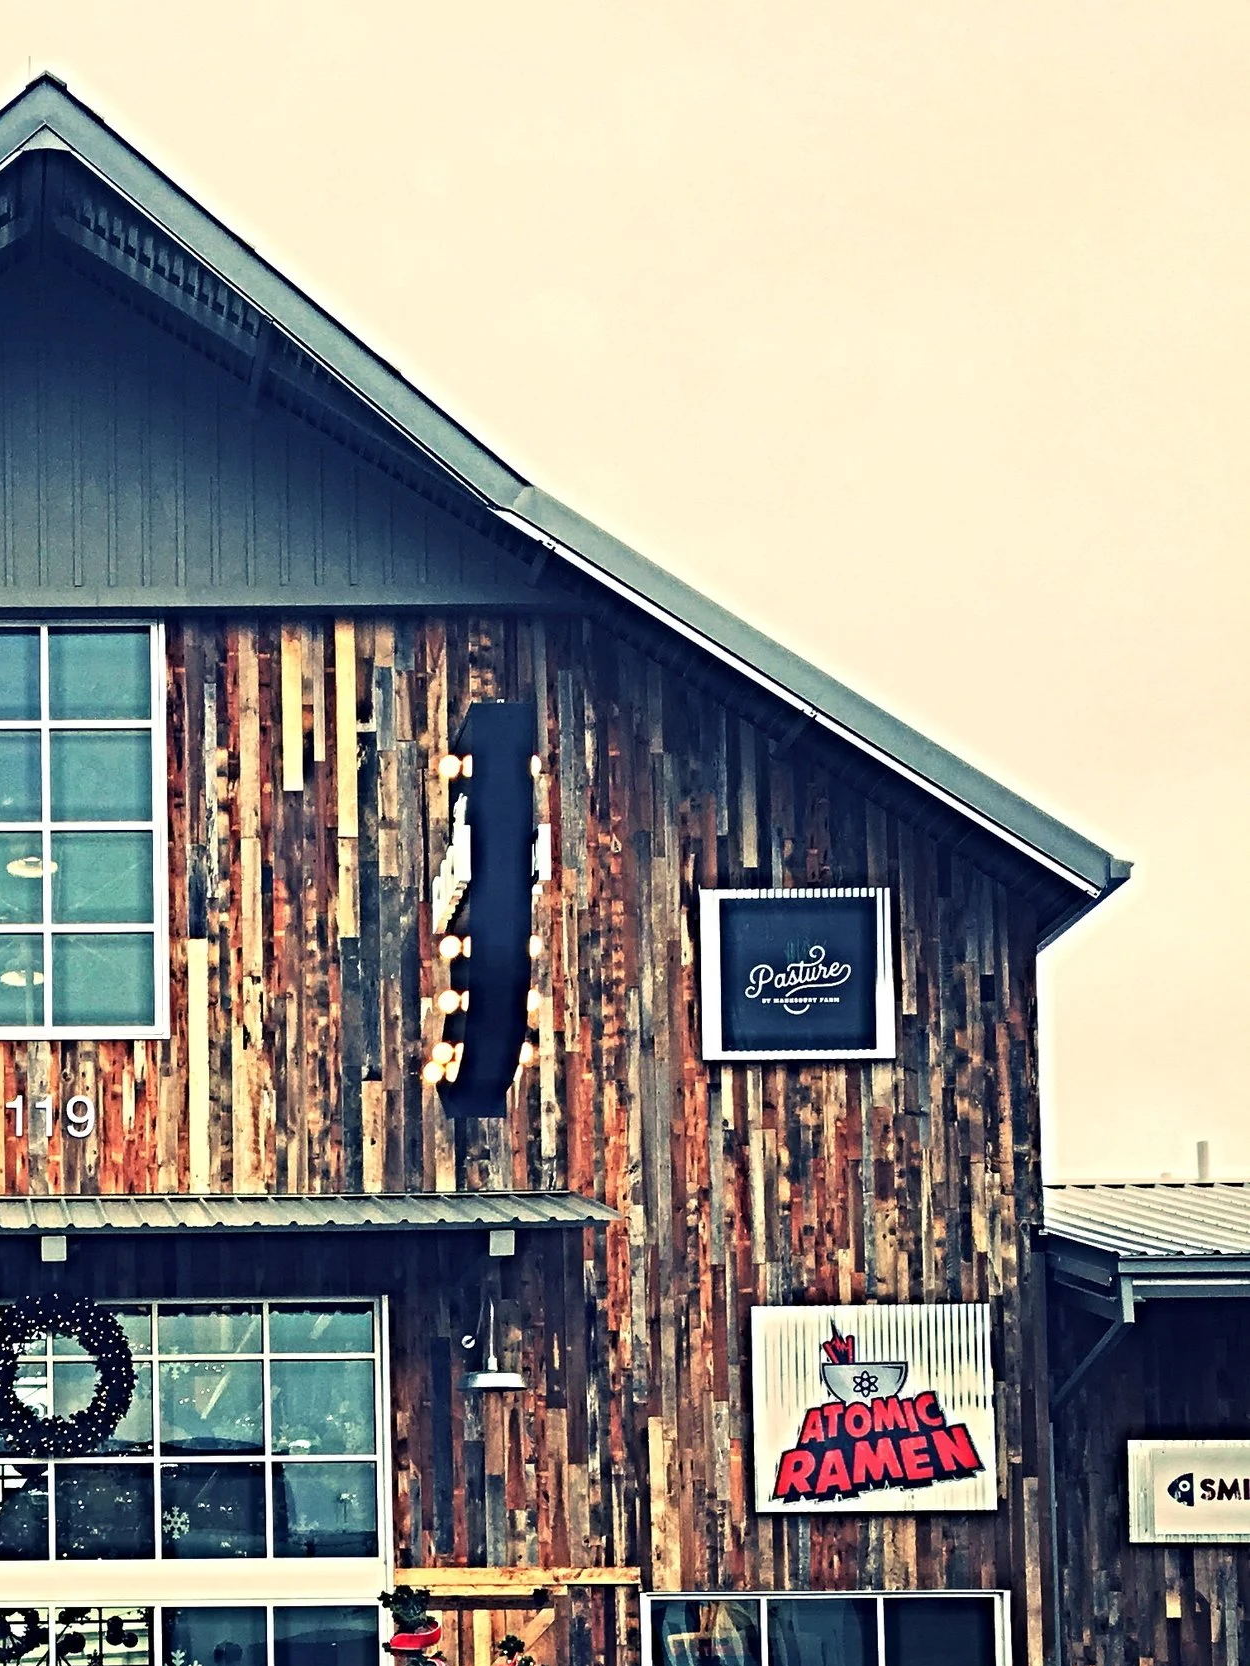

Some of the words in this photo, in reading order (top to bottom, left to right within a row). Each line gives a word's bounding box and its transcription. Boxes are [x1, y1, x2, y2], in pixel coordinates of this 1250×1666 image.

[745, 945, 851, 998] Pasture
[5, 1094, 95, 1138] 119
[798, 1391, 947, 1446] ATOMIC
[774, 1424, 981, 1497] RAMEN
